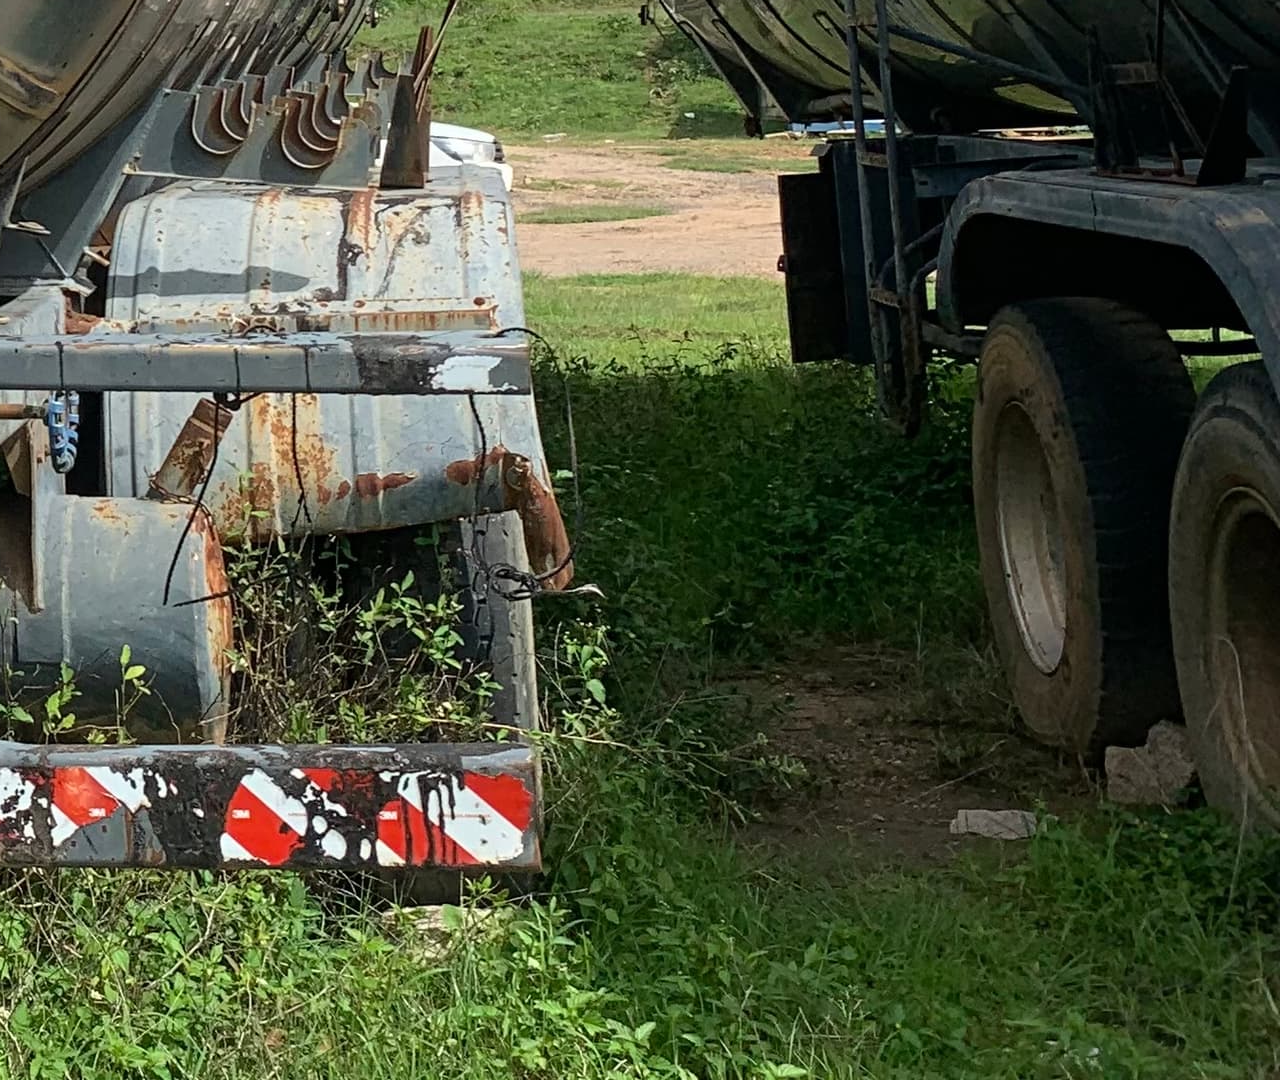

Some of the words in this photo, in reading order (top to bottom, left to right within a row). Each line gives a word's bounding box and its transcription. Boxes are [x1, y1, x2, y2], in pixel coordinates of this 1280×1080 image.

[88, 807, 106, 817] 3M
[232, 809, 250, 819] 3M
[379, 811, 397, 821] 3M
